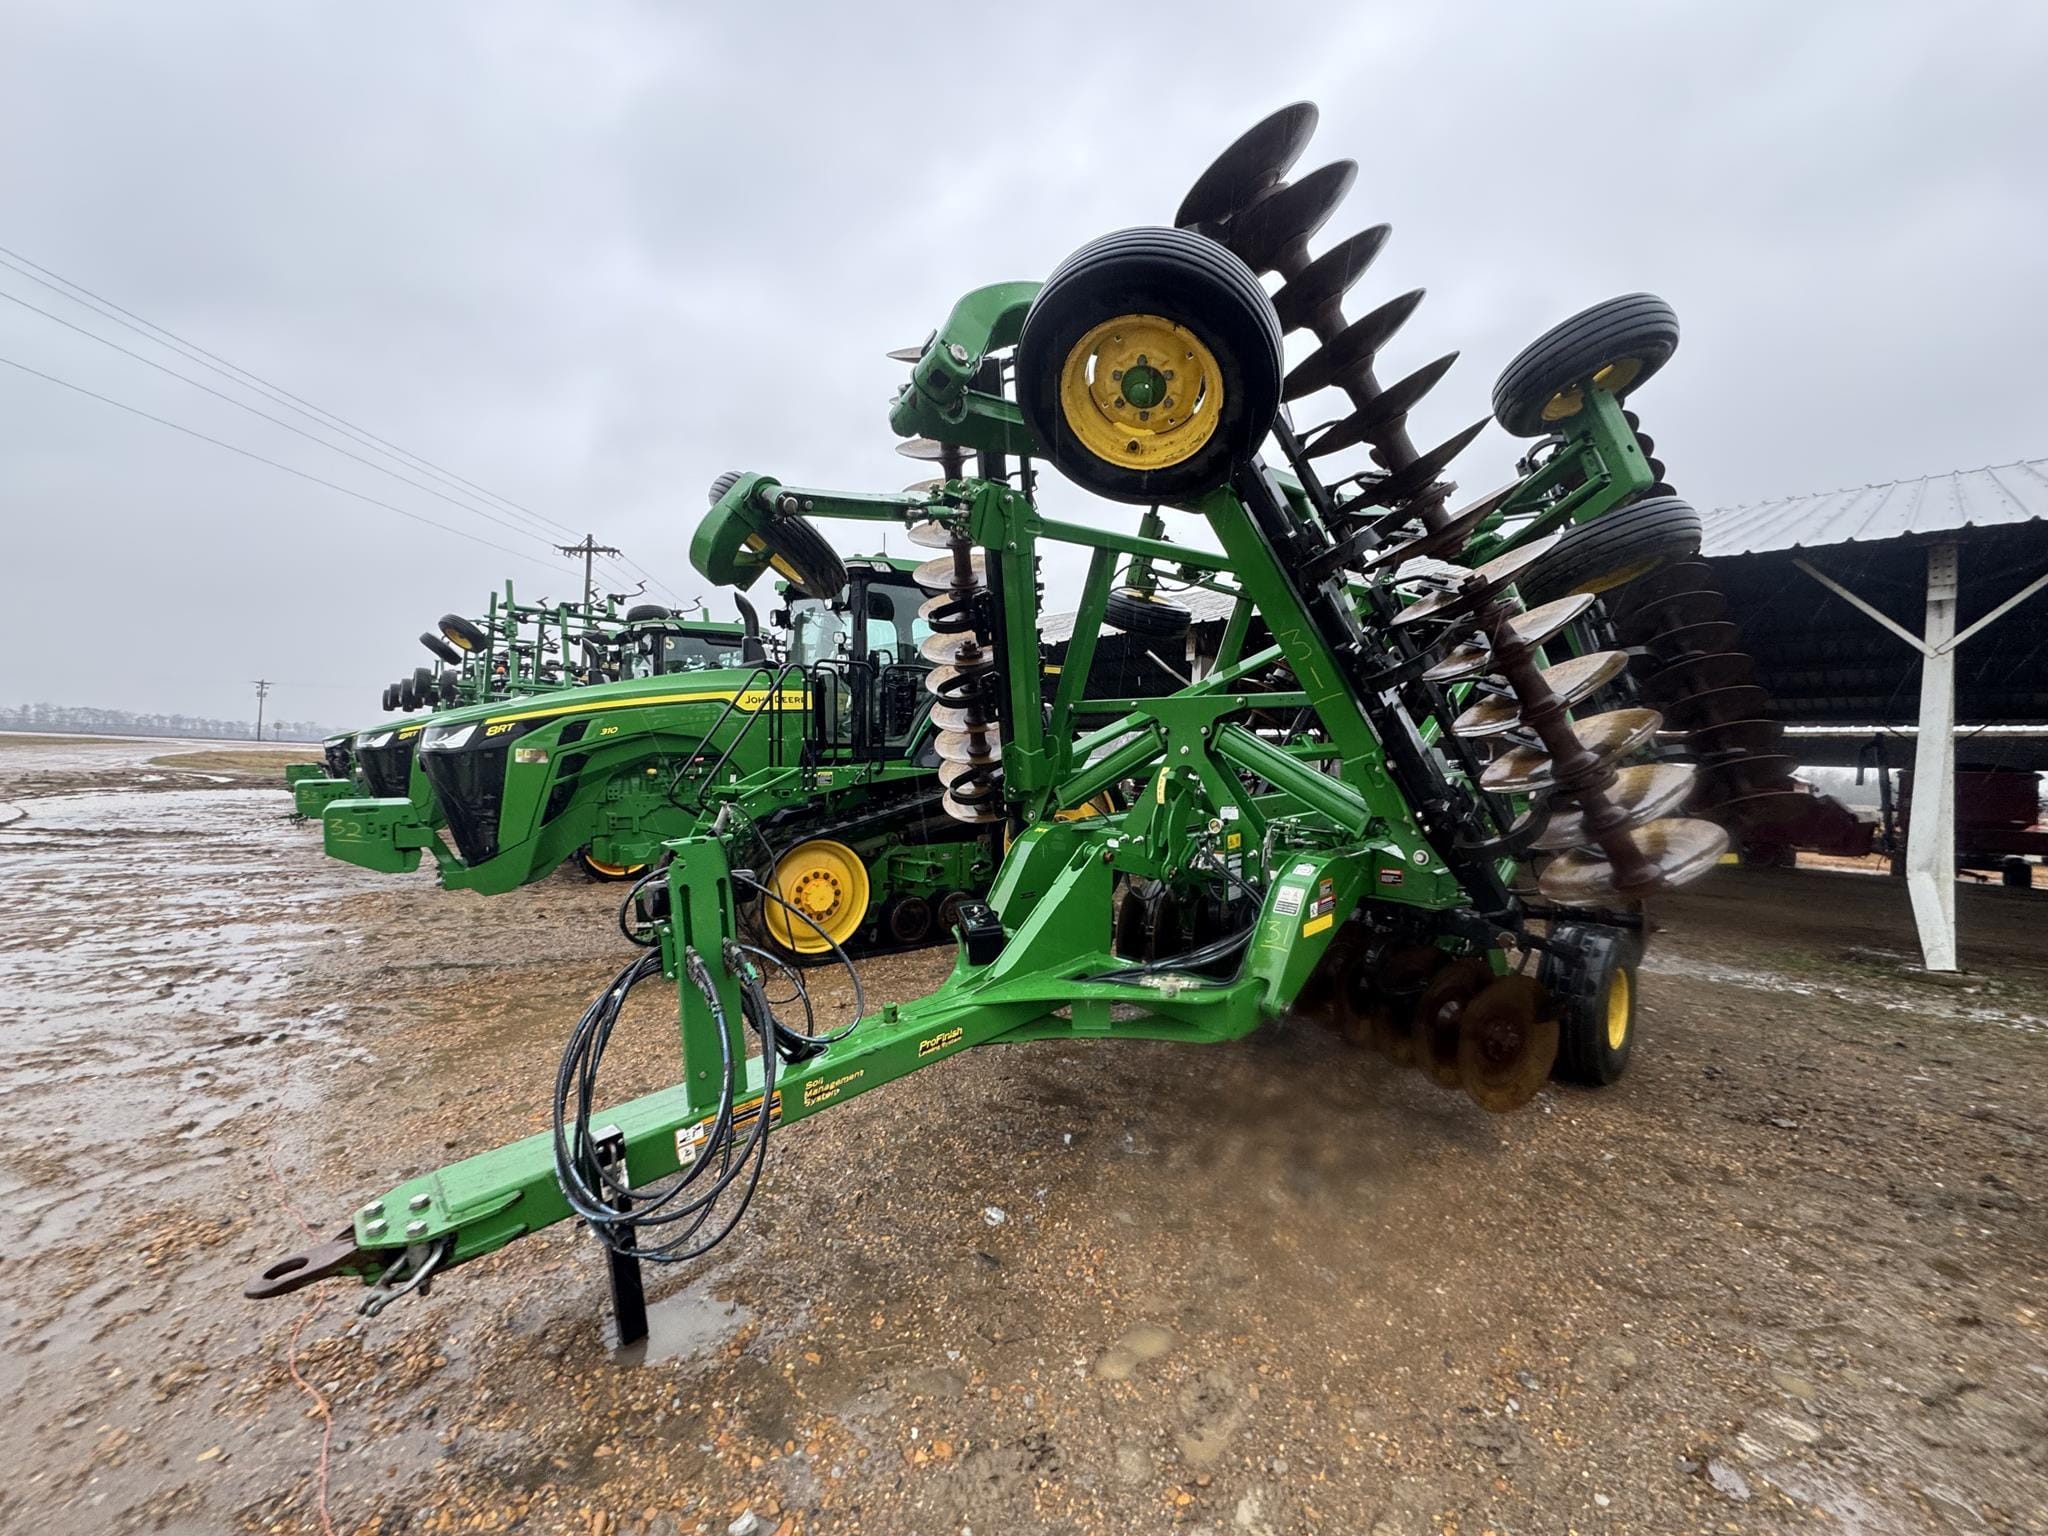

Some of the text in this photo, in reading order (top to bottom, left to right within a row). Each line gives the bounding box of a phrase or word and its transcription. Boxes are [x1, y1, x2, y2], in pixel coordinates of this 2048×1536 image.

[745, 696, 771, 704] JOH
[485, 723, 516, 737] 8RT
[600, 726, 619, 736] 310
[329, 818, 363, 839] 32
[1263, 920, 1291, 946] 31
[919, 1026, 963, 1052] ProFinish
[804, 1069, 865, 1100] Management
[805, 1076, 824, 1090] Soil
